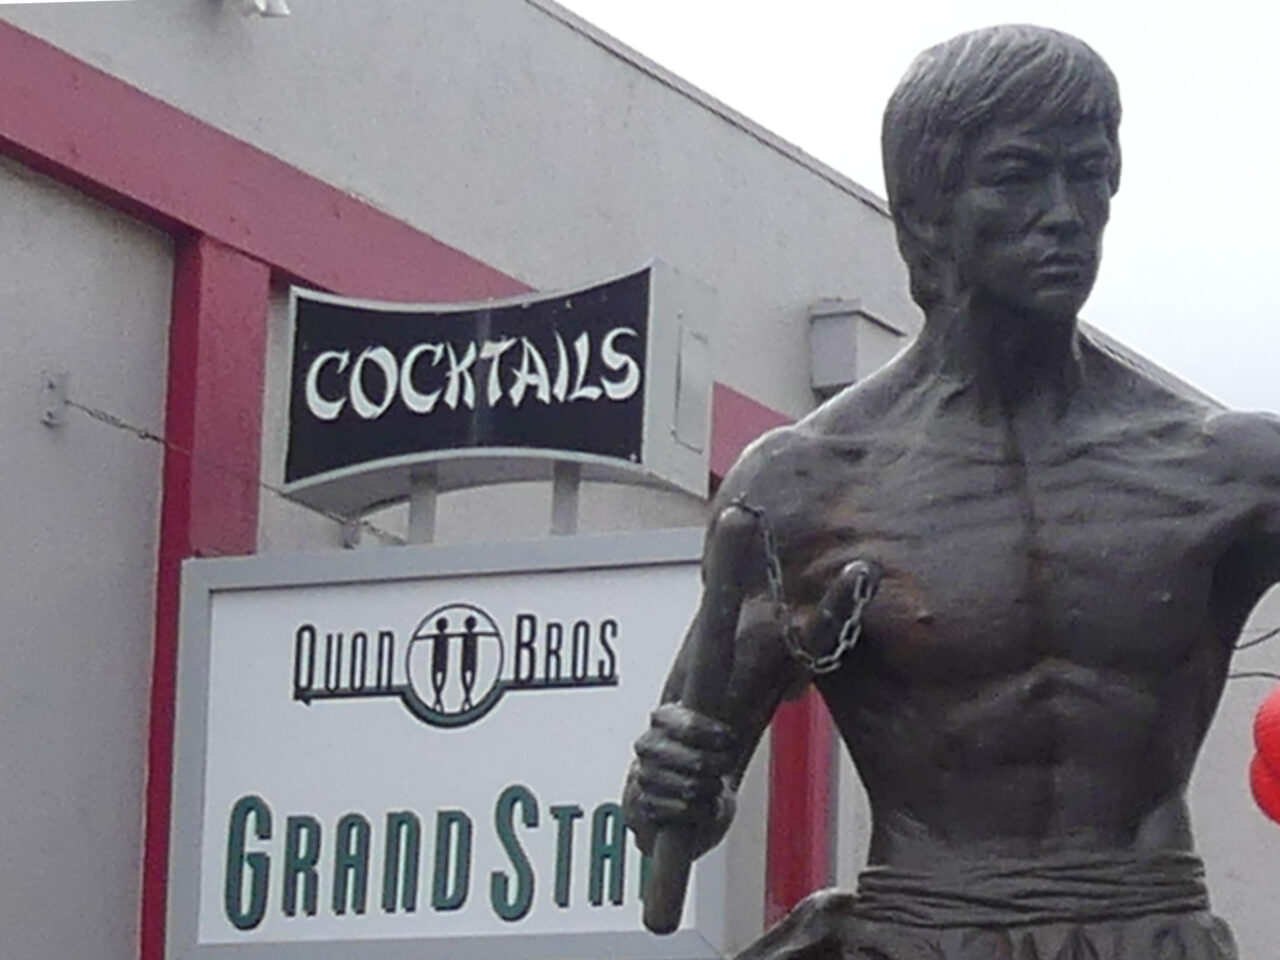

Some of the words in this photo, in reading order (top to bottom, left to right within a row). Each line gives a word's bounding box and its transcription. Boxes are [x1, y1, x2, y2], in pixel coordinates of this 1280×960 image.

[305, 327, 641, 421] COCKTAILS
[224, 795, 474, 931] GRAND
[490, 784, 654, 923] STA
